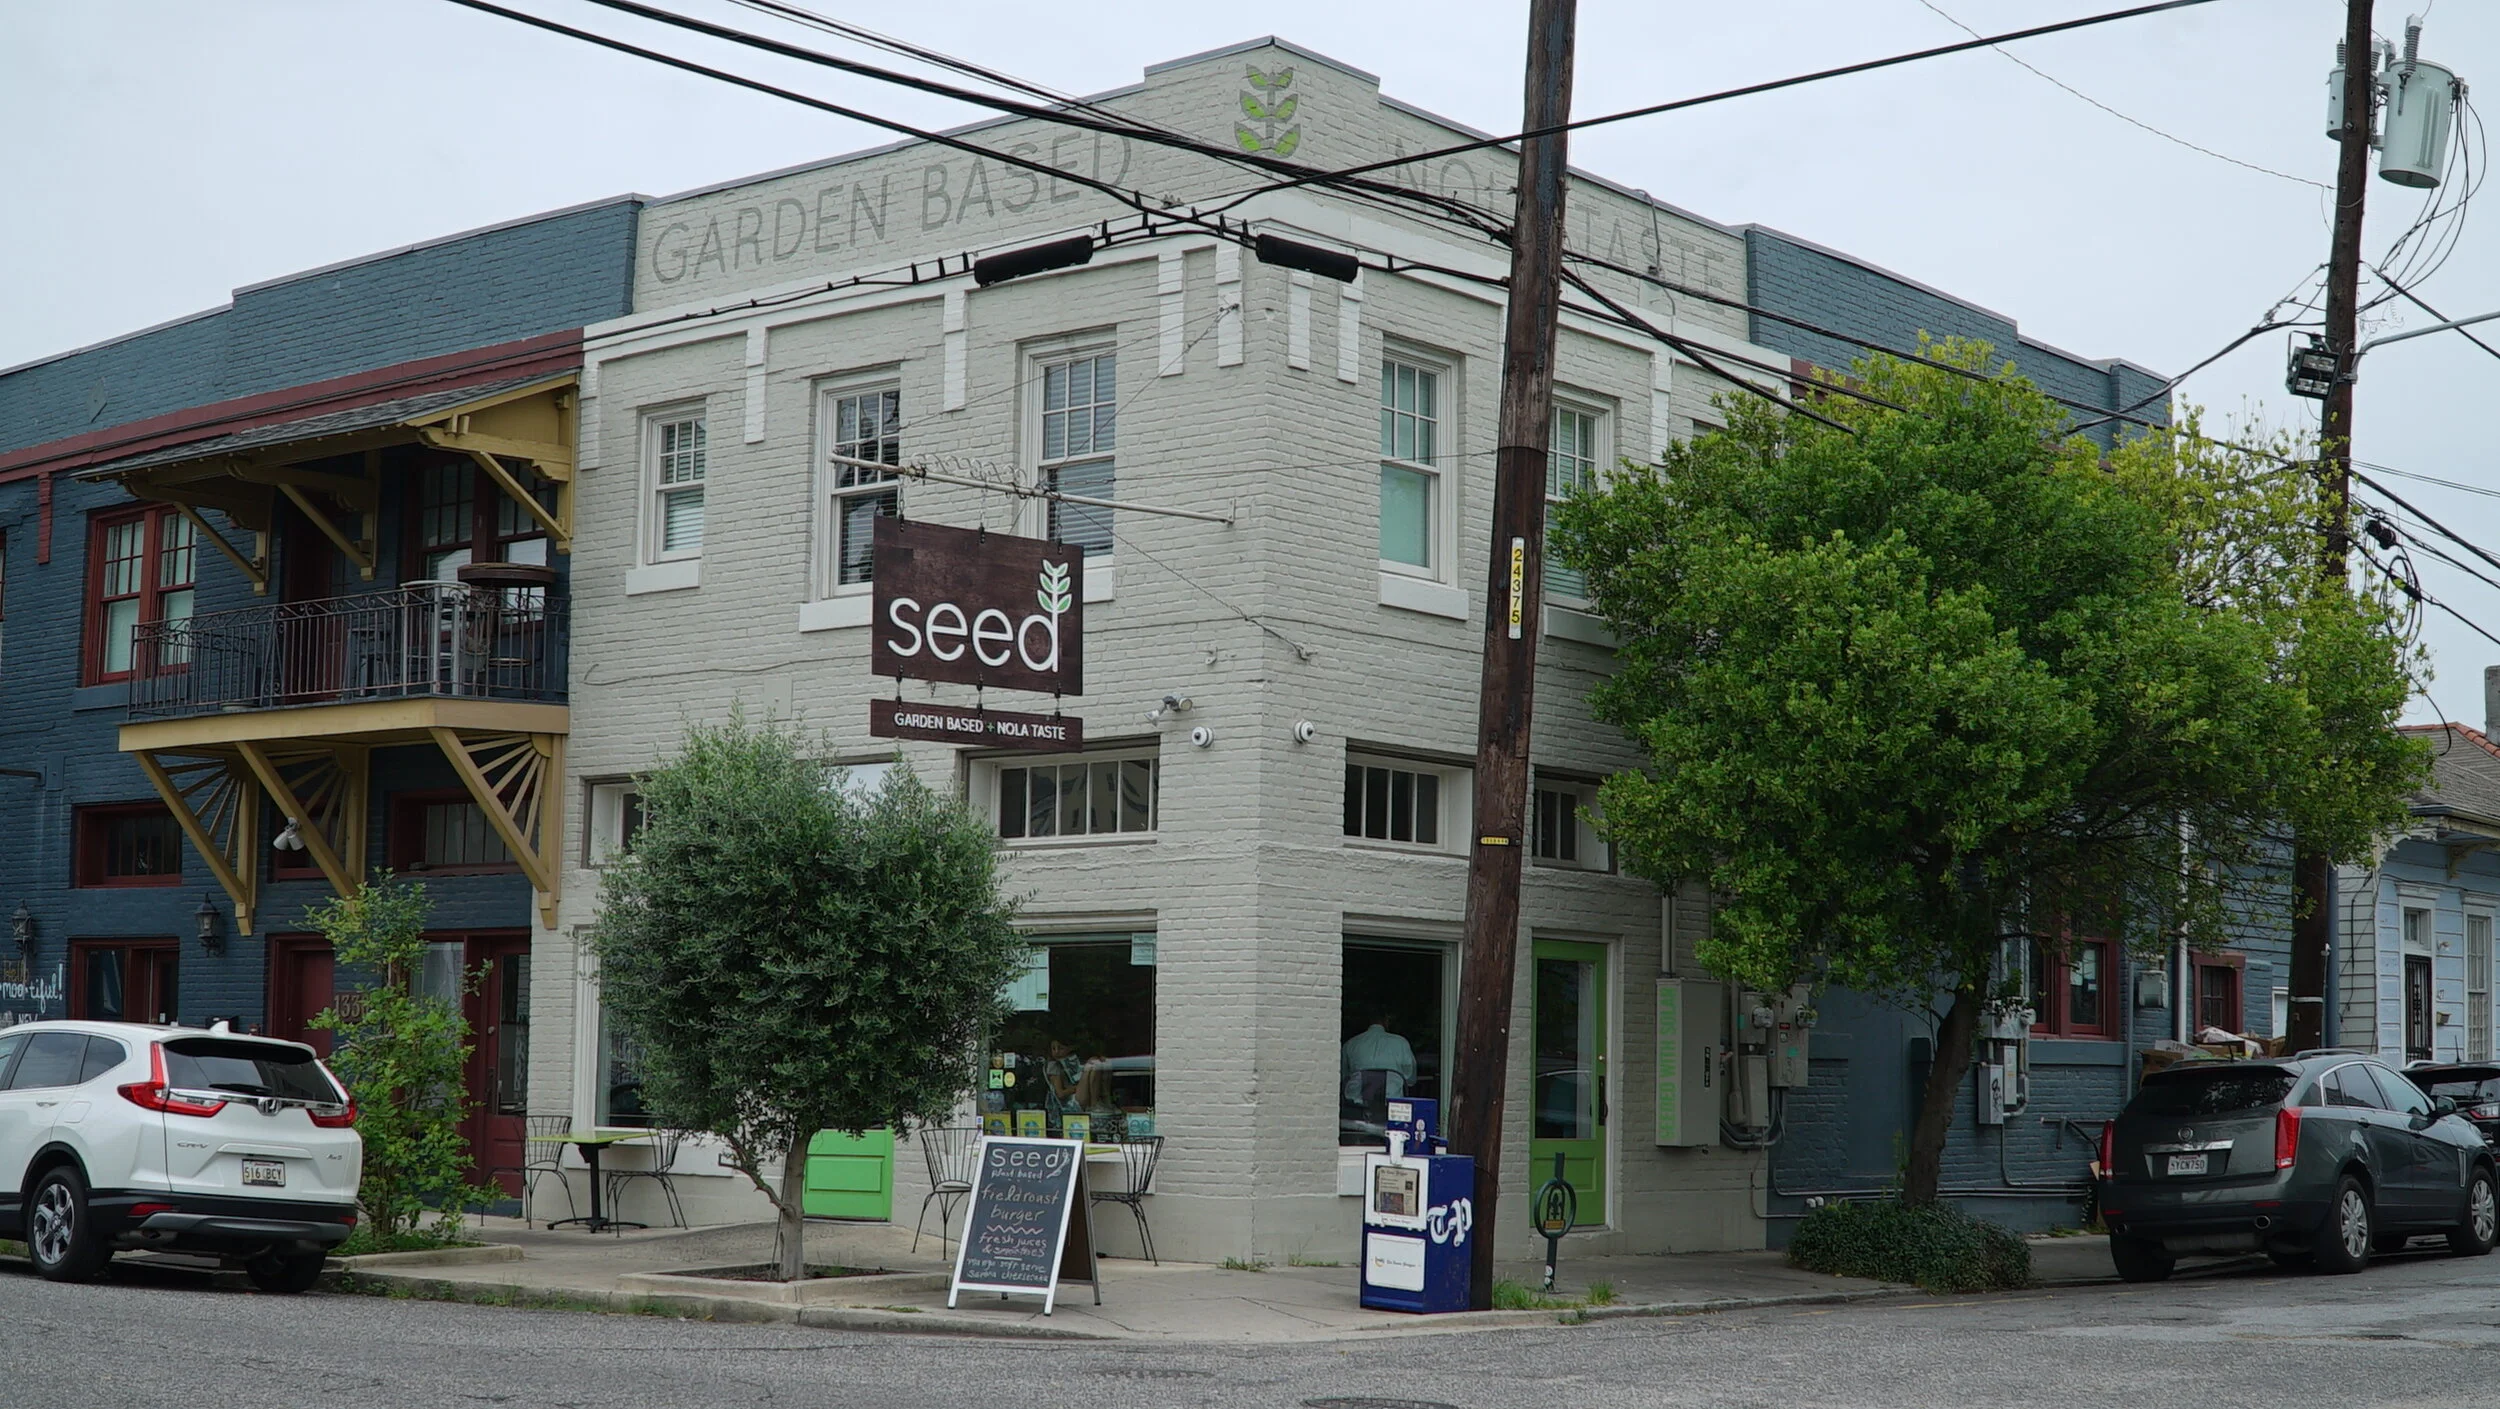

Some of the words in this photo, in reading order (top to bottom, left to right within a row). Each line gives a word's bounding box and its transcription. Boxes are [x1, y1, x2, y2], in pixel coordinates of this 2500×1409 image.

[652, 175, 888, 284] GARDEN
[920, 128, 1132, 231] BASED
[1511, 548, 1523, 624] 24375
[888, 566, 1061, 673] seed
[894, 712, 943, 729] GARDEN
[946, 717, 984, 733] BASED
[997, 721, 1029, 737] NOLA
[1031, 724, 1066, 740] TASTE
[979, 1231, 1014, 1244] fresh
[990, 1204, 1045, 1226] burger
